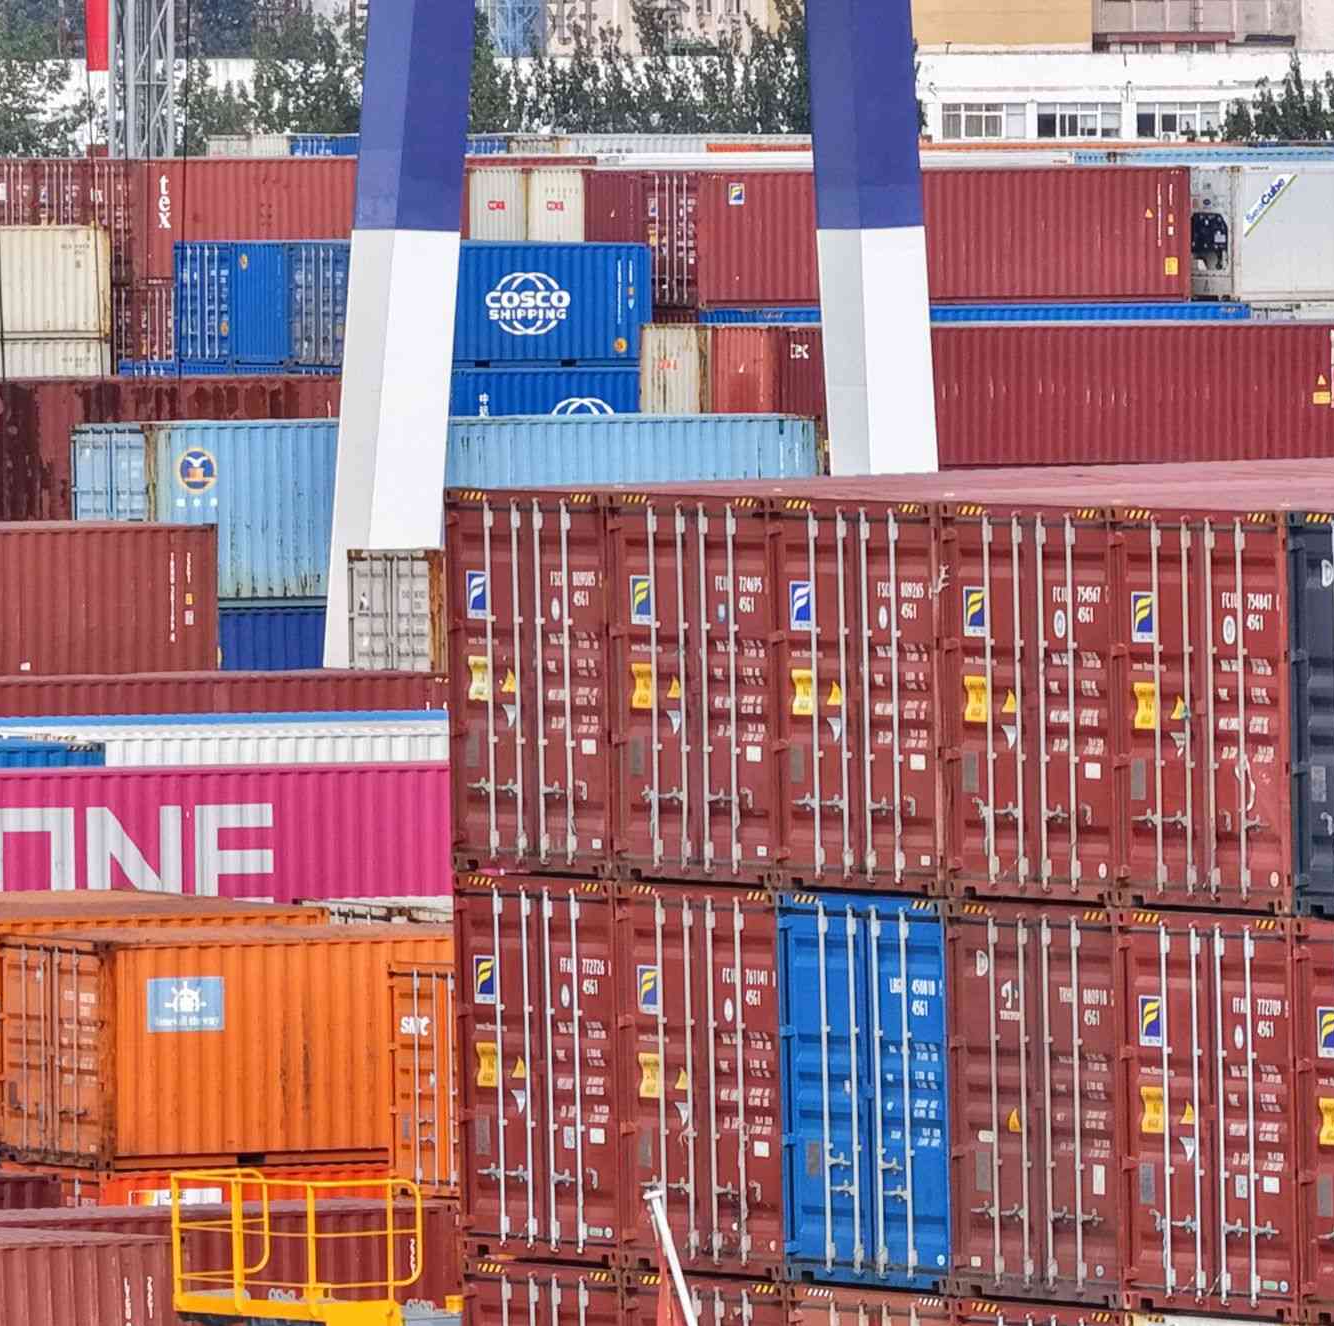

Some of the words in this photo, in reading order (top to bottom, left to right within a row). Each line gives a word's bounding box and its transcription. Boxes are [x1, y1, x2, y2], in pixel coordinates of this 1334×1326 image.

[158, 175, 172, 229] tex
[1245, 177, 1287, 224] SeaCube
[485, 291, 572, 308] COSCO
[489, 309, 567, 321] SHIPPING
